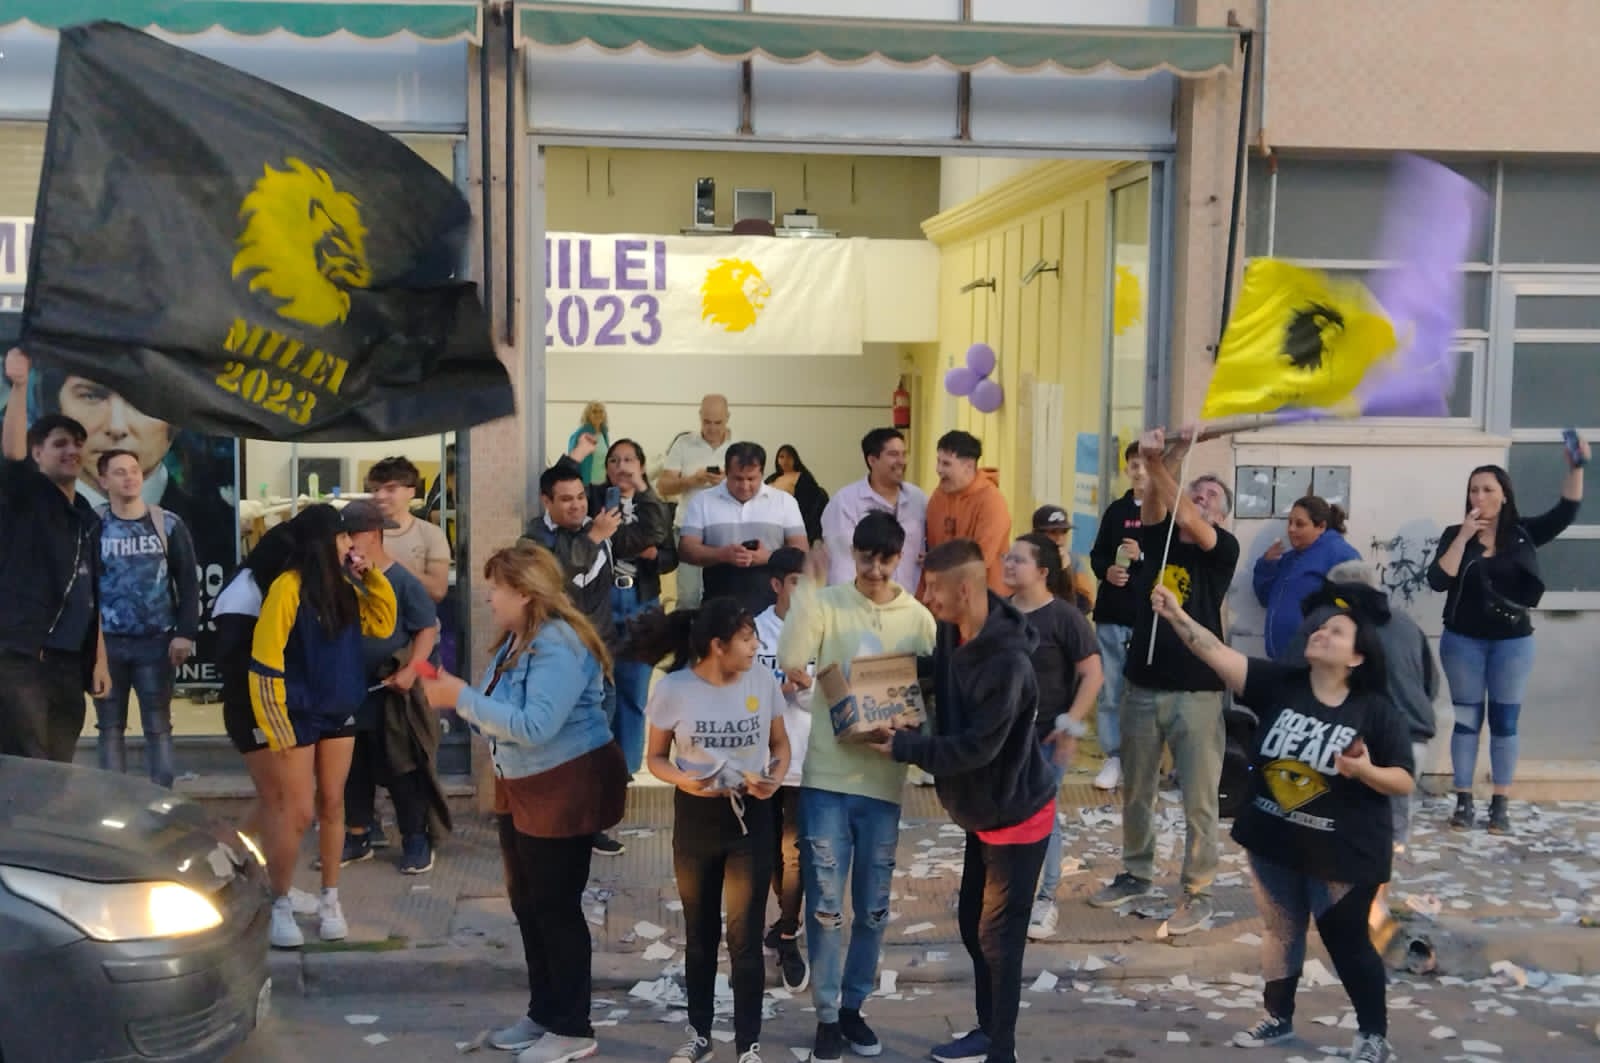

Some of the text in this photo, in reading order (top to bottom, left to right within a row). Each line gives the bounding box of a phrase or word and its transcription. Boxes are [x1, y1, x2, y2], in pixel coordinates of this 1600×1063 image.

[223, 316, 349, 395] MILEI
[215, 361, 317, 425] 2023
[695, 715, 760, 734] BLACK
[1271, 707, 1358, 749] ROCK IS
[1259, 727, 1342, 776] DEAD
